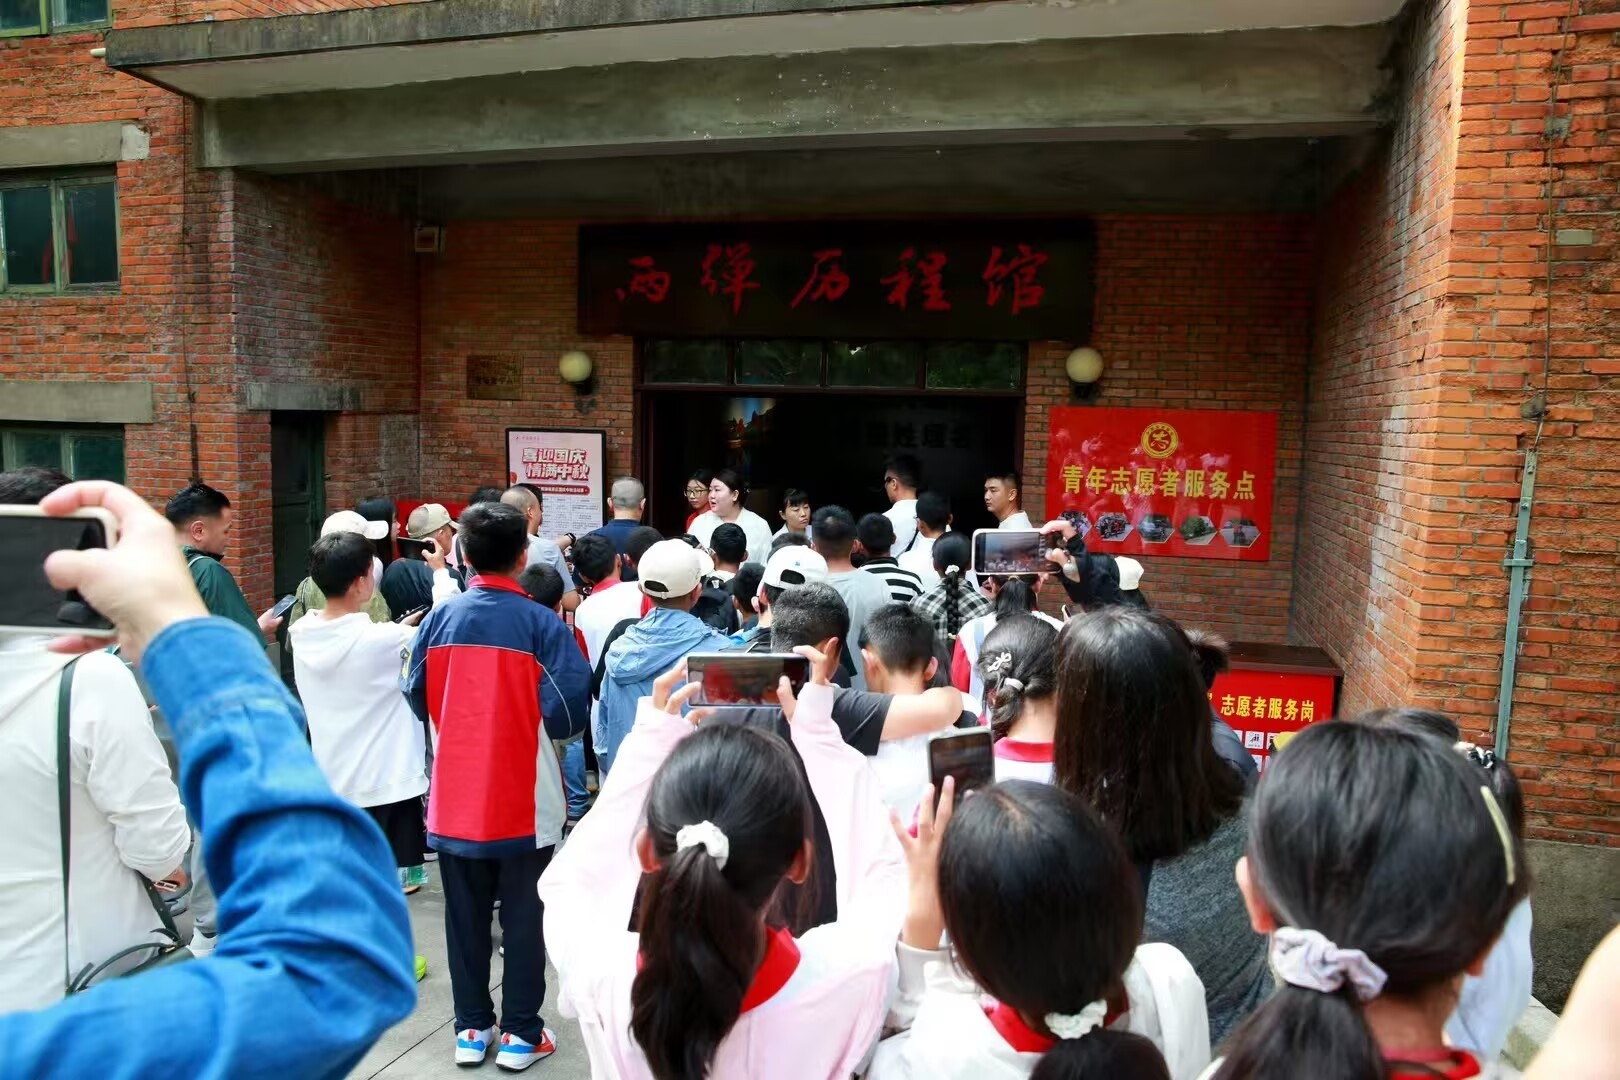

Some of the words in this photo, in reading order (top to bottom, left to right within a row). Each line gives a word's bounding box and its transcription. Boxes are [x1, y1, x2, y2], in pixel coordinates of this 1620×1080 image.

[617, 242, 1049, 314] 两弹历程馆
[522, 447, 586, 464] 喜迎国庆
[526, 462, 589, 480] 情满中秋
[1062, 465, 1256, 500] 青年志愿者服务点
[1220, 693, 1315, 722] 志愿者服务岗
